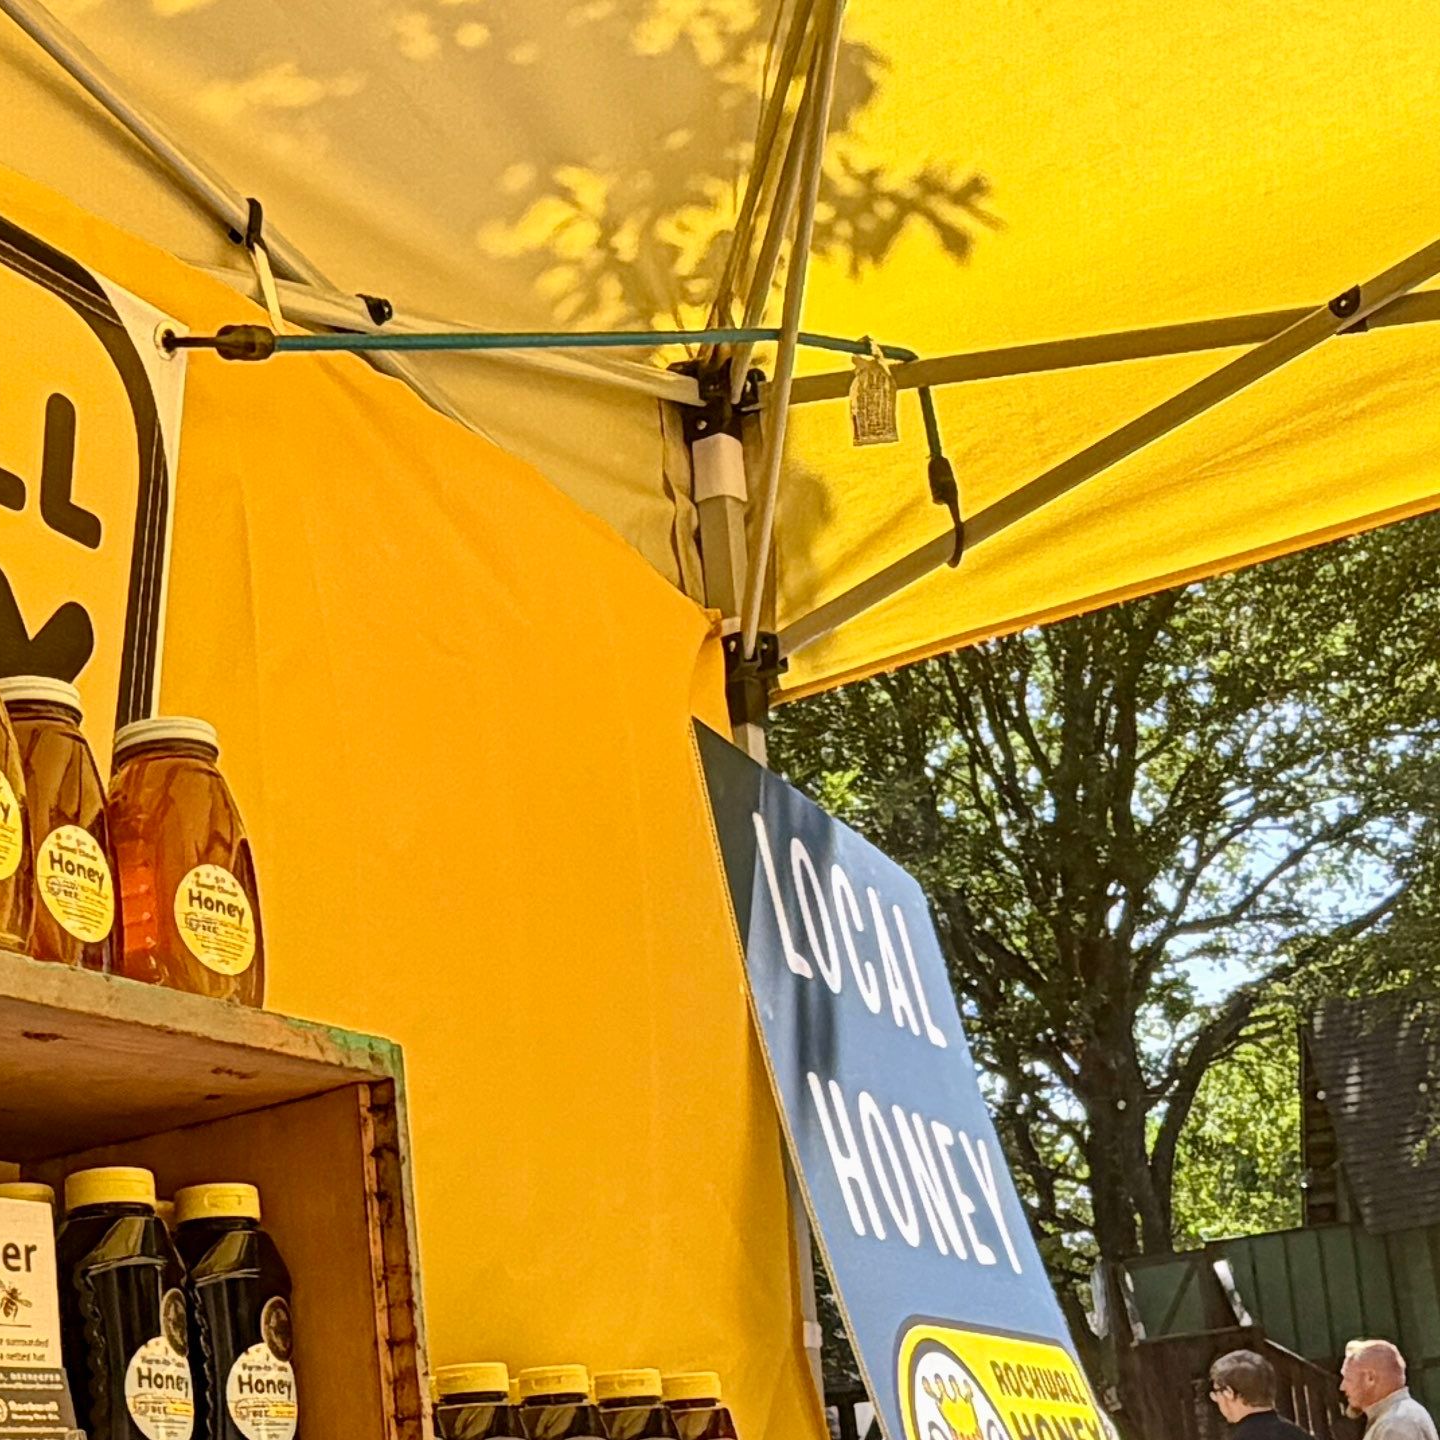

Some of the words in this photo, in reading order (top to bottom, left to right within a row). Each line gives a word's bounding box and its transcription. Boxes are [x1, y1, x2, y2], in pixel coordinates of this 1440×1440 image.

[49, 851, 104, 892] Honey
[189, 889, 244, 928] Honey
[753, 811, 947, 1049] LOCAL
[807, 1071, 1022, 1274] HONEY
[137, 1367, 188, 1398] Honey
[238, 1374, 291, 1400] Honey
[990, 1360, 1087, 1406] ROCKWALL
